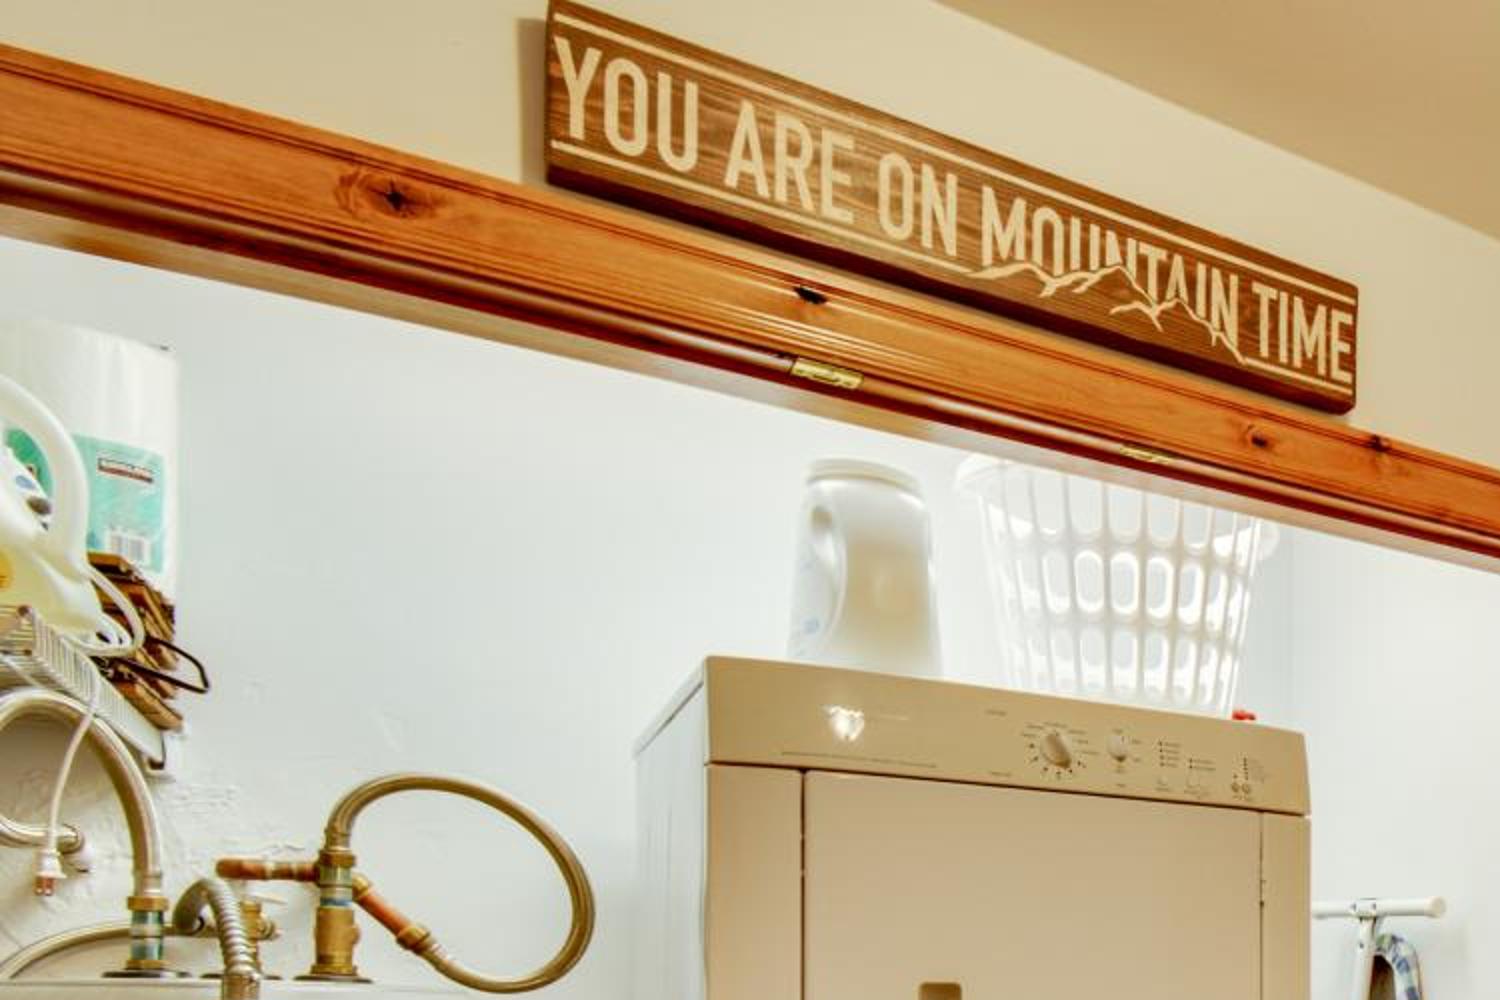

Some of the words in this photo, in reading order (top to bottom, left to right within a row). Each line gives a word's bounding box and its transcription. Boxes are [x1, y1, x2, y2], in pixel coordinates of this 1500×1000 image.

[553, 35, 700, 173] YOU
[723, 99, 855, 225] ARE
[877, 152, 958, 257] ON
[981, 185, 1239, 351] MOUNTAIN
[1251, 281, 1354, 384] TIME
